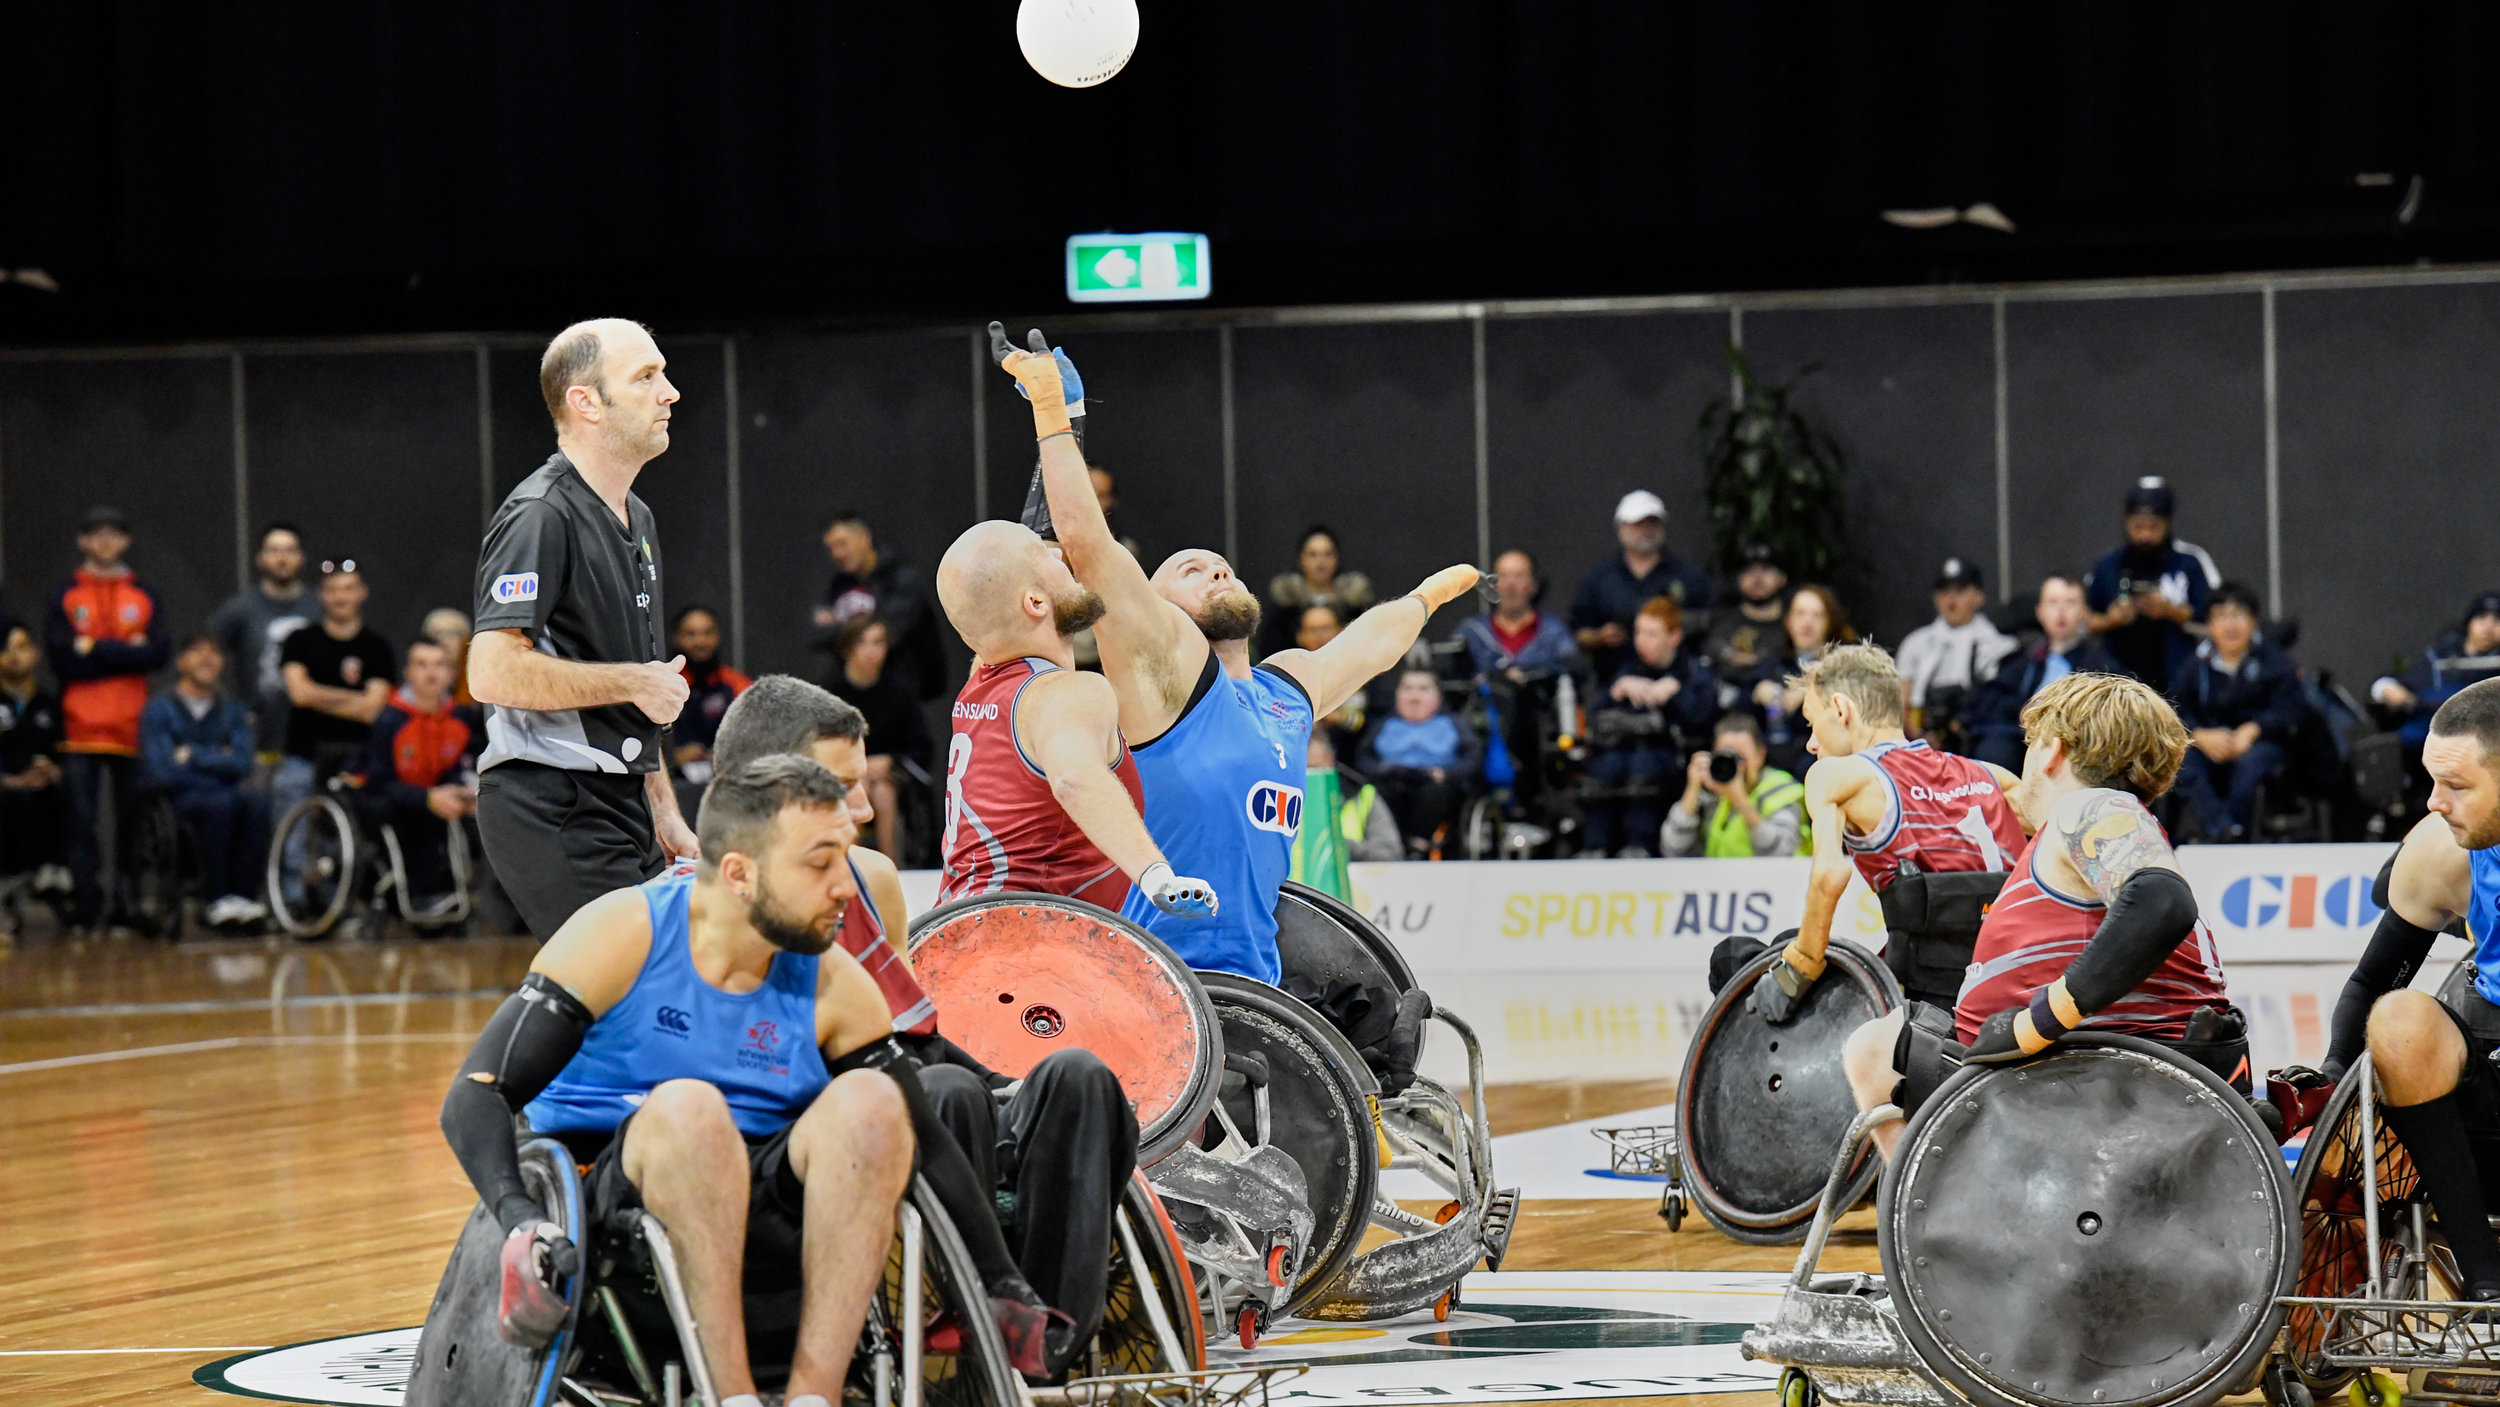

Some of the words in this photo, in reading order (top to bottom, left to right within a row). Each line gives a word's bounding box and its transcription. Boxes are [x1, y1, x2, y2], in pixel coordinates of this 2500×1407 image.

[499, 578, 537, 598] GIO
[1274, 743, 1287, 770] 3
[1252, 787, 1302, 831] GIO
[1500, 889, 1774, 938] SPORTAUS
[2220, 872, 2387, 930] GIO
